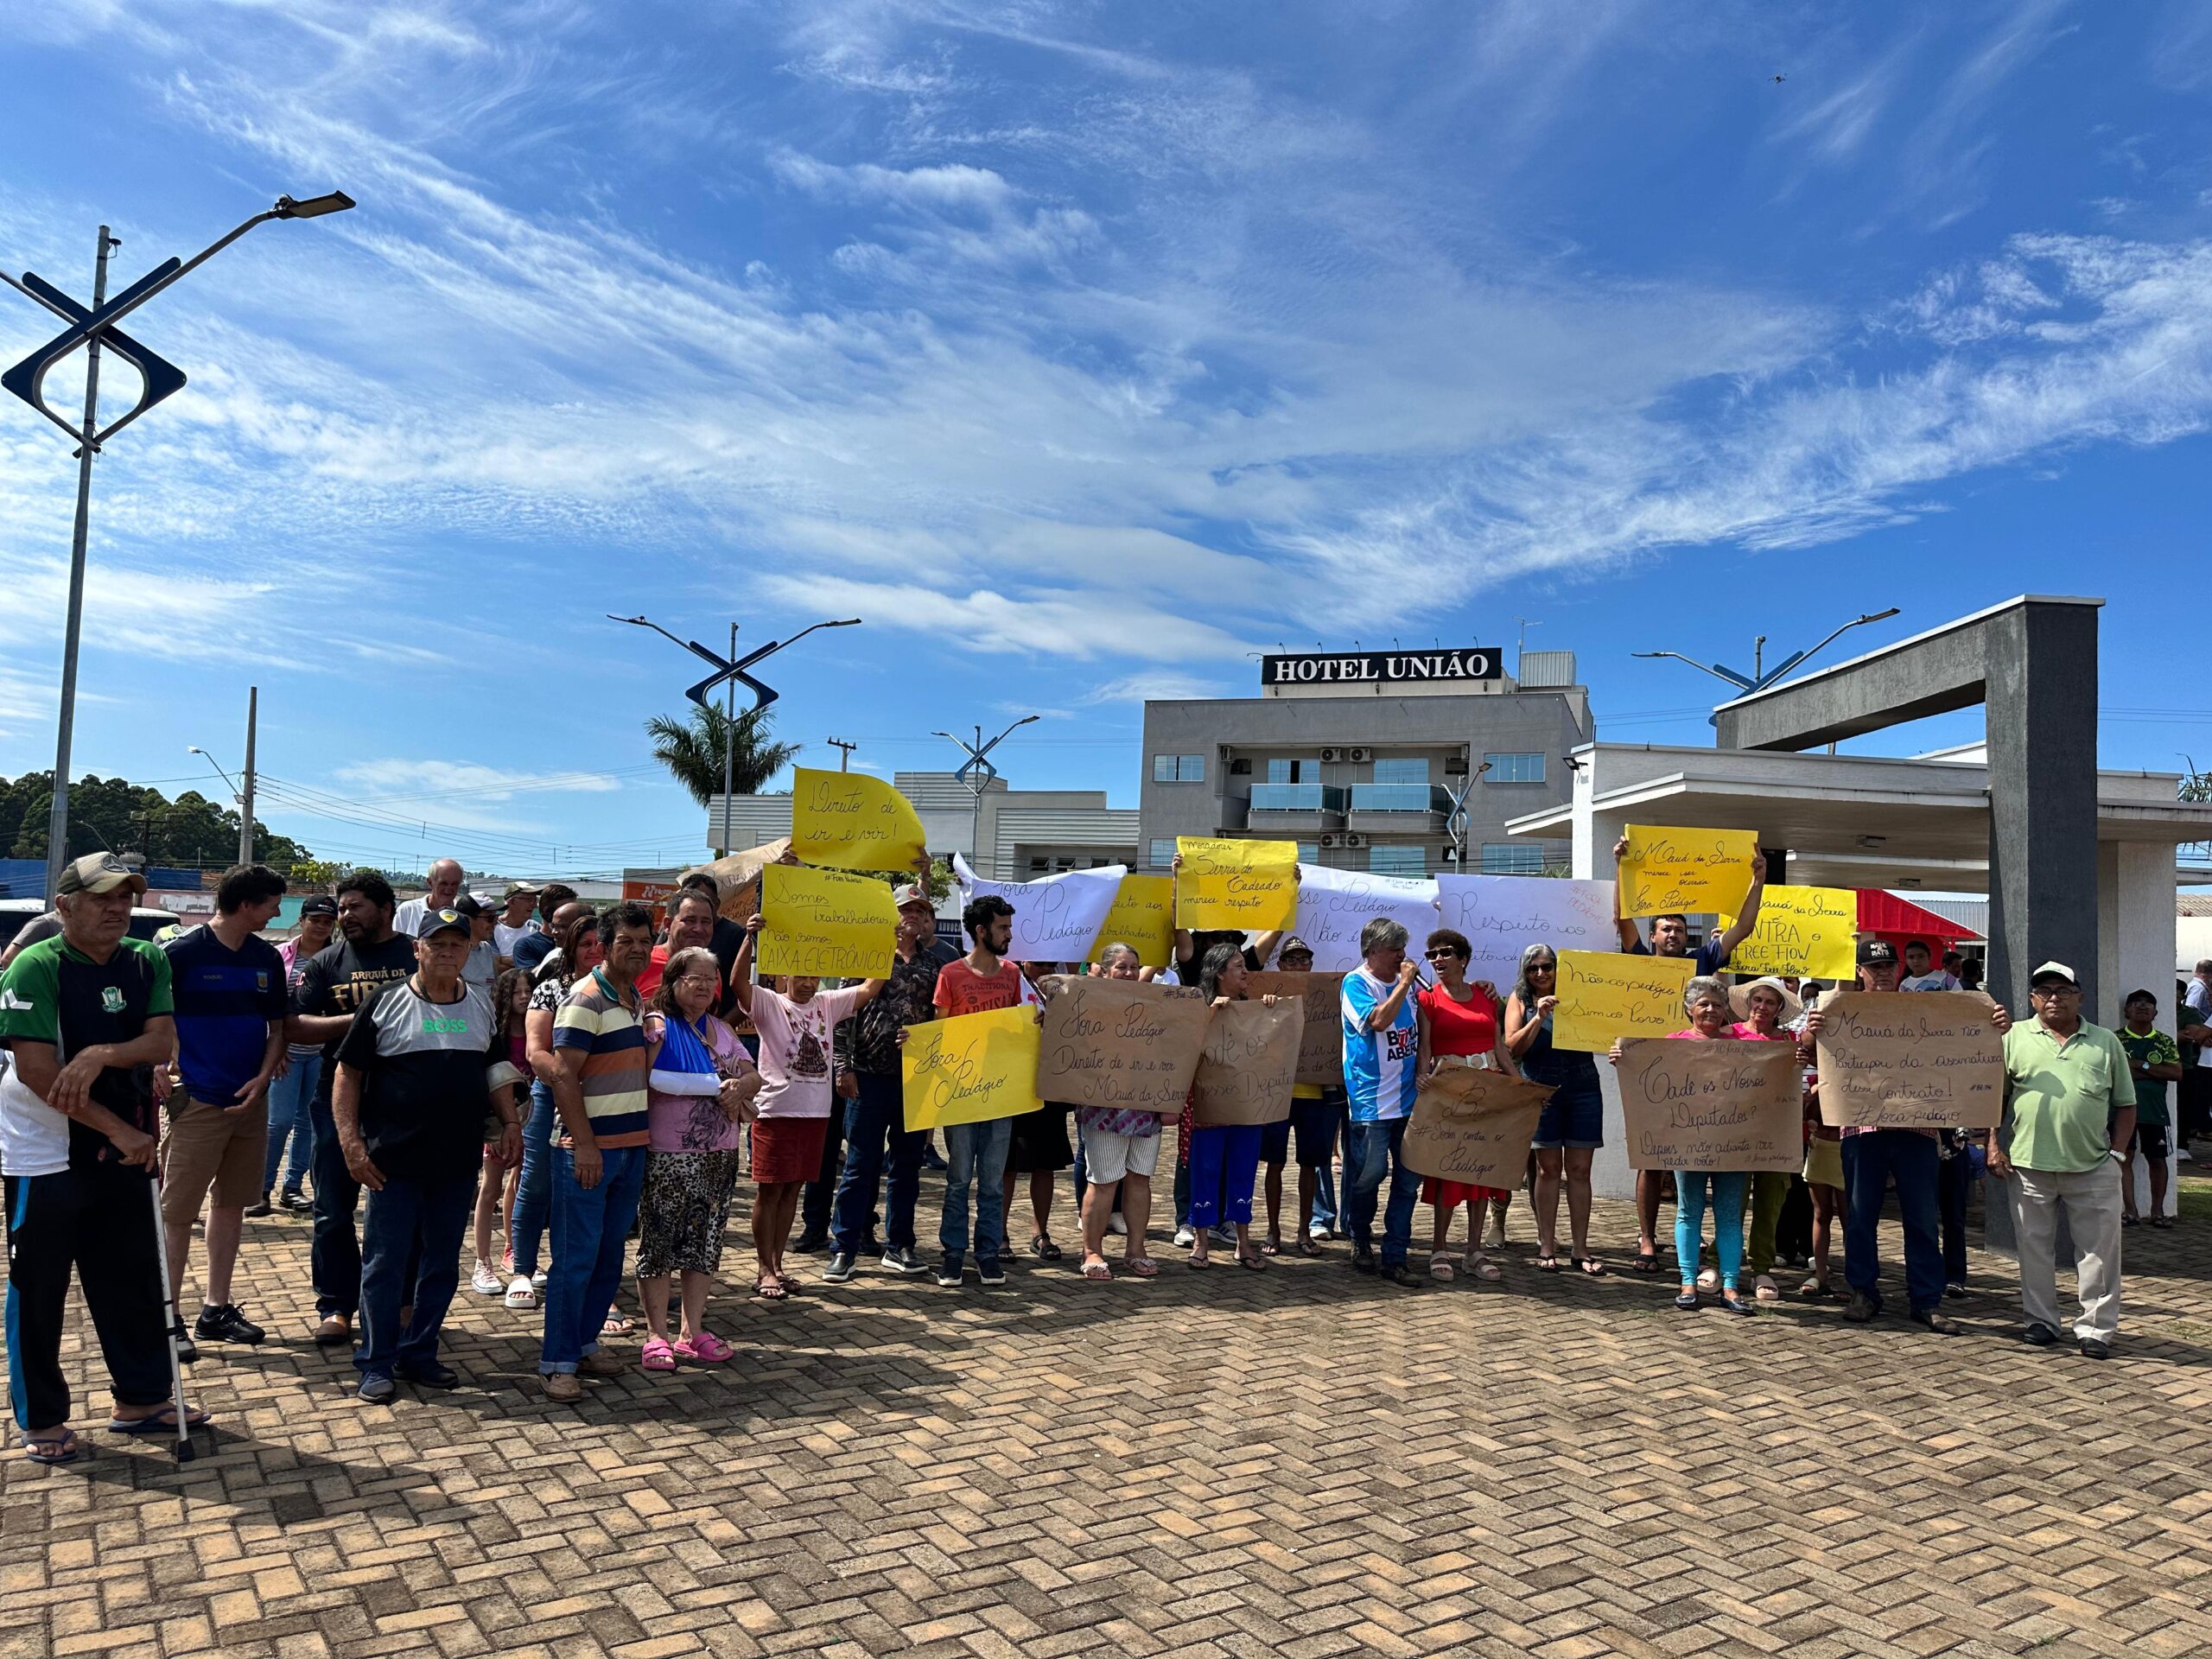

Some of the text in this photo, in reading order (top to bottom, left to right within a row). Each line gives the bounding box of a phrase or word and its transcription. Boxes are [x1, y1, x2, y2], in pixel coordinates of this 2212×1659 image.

[1274, 651, 1488, 681] HOTEL UNIÃO
[880, 796, 899, 814] de
[804, 823, 833, 841] ir
[839, 830, 855, 841] e
[1194, 855, 1253, 875] Serra do
[1634, 840, 1743, 867] Mauá da Serra
[766, 873, 830, 905] Somos
[1227, 875, 1283, 893] Cadeado
[1297, 890, 1322, 905] sse
[1330, 878, 1400, 917] Pedágio
[1145, 902, 1163, 911] aos
[1184, 893, 1263, 912] merece respeito
[1630, 885, 1697, 912] Fora Pedágio
[1808, 893, 1847, 917] Serra
[1020, 880, 1098, 947] Pedágio
[1448, 891, 1551, 934] Respeito
[795, 932, 833, 944] somos
[1303, 912, 1342, 943] Não
[760, 944, 800, 971] CAIXA
[1734, 943, 1769, 960] FREE
[352, 967, 407, 981] ARRAIÁ DA
[1060, 989, 1105, 1038] Fora
[1116, 997, 1166, 1046] Pedágio
[1561, 998, 1605, 1017] Sim
[422, 1019, 468, 1033] BOSS
[1827, 1011, 1981, 1044] Mauá da Serra não
[914, 1033, 961, 1074] Fora
[1246, 1035, 1268, 1057] os
[934, 1039, 1007, 1108] Pedágio
[1052, 1046, 1103, 1075] Direito
[1109, 1053, 1123, 1069] de
[1128, 1060, 1144, 1071] ir
[1145, 1062, 1155, 1071] e
[1831, 1048, 1891, 1074] Participou
[1900, 1053, 1923, 1068] da
[1084, 1074, 1136, 1102] Mauá
[1139, 1085, 1153, 1102] da
[1639, 1056, 1767, 1103] Cadê os Nossos
[1841, 1077, 1874, 1093] desse
[1640, 1130, 1678, 1161] Depois
[1686, 1141, 1712, 1153] não
[1440, 1141, 1497, 1180] Pedágio
